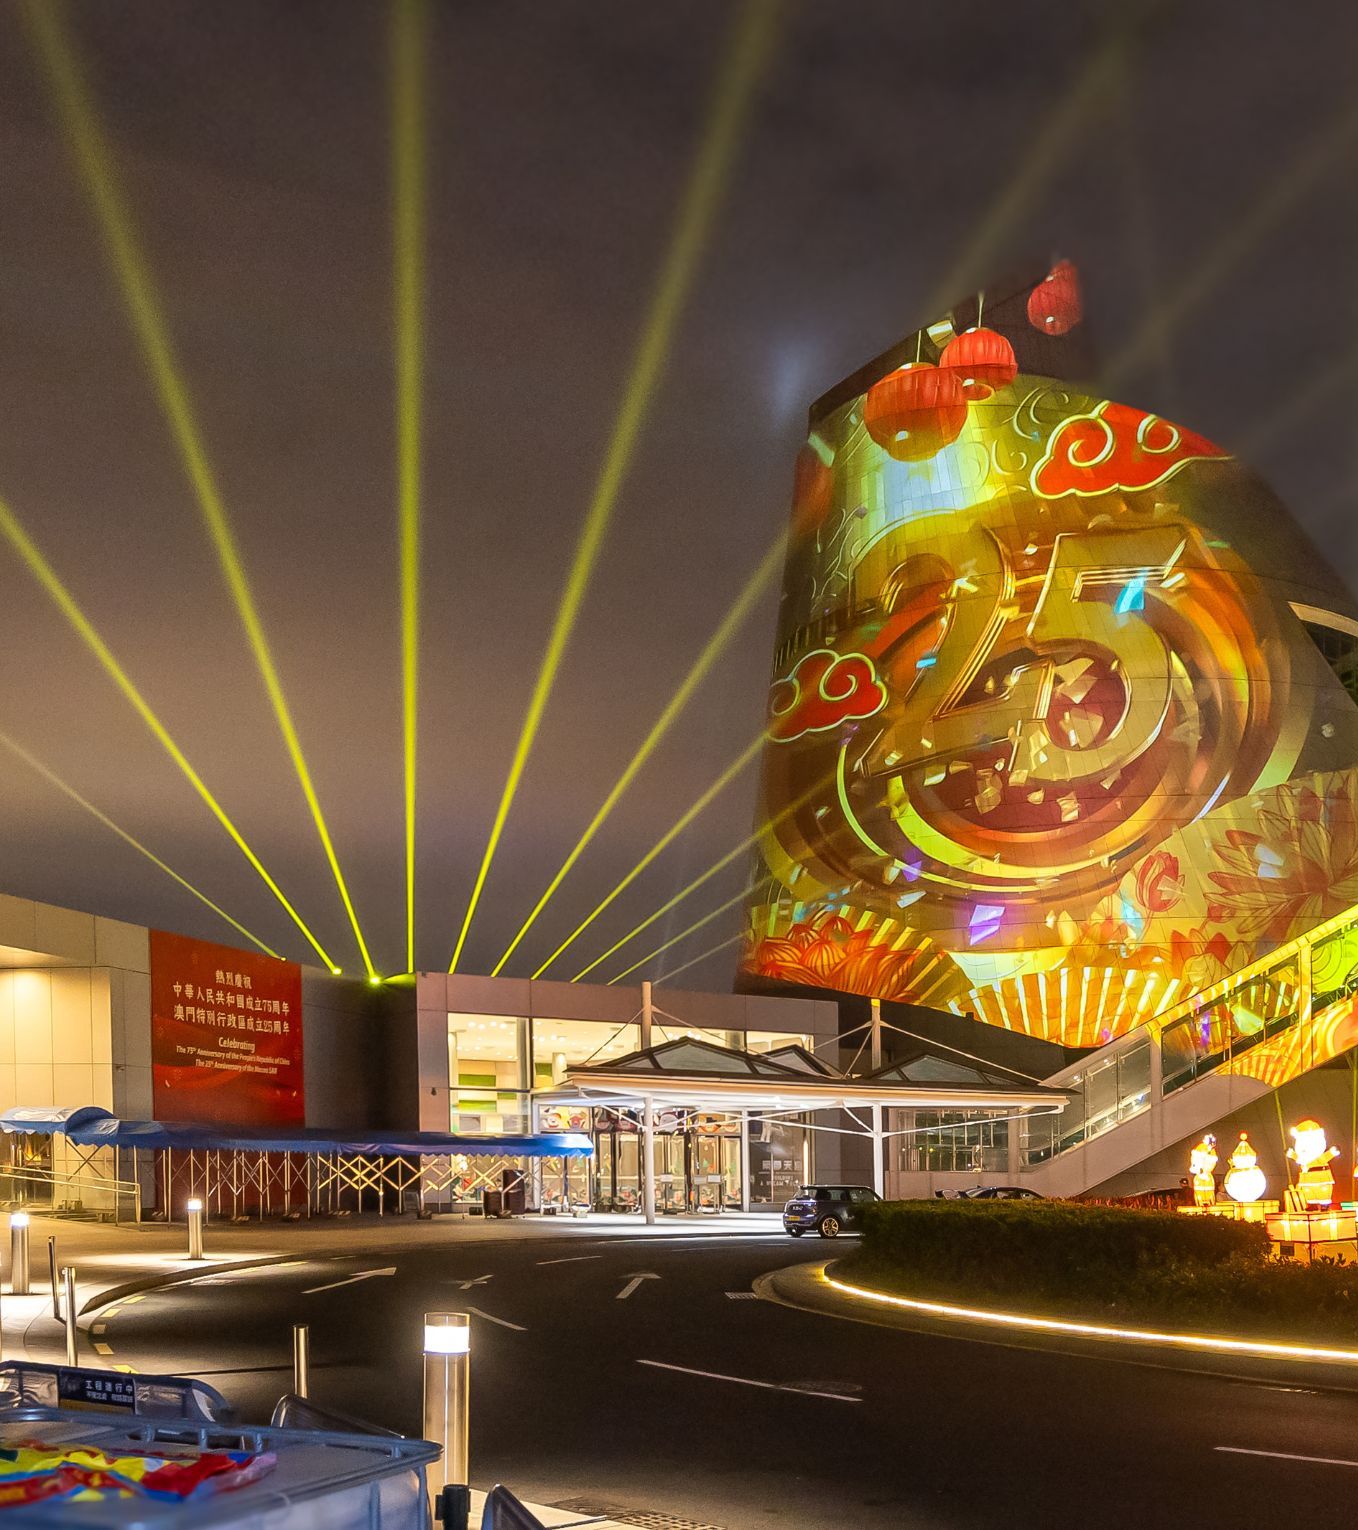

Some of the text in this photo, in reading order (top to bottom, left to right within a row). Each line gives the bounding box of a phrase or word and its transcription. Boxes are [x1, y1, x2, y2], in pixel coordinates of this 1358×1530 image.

[850, 512, 1190, 786] 25
[215, 969, 252, 989] 熱烈慶祝
[176, 1045, 186, 1054] The
[197, 1048, 225, 1059] Anniversary
[218, 1037, 255, 1053] Celebrating
[196, 1059, 205, 1067] The
[214, 1061, 242, 1072] Anniversary
